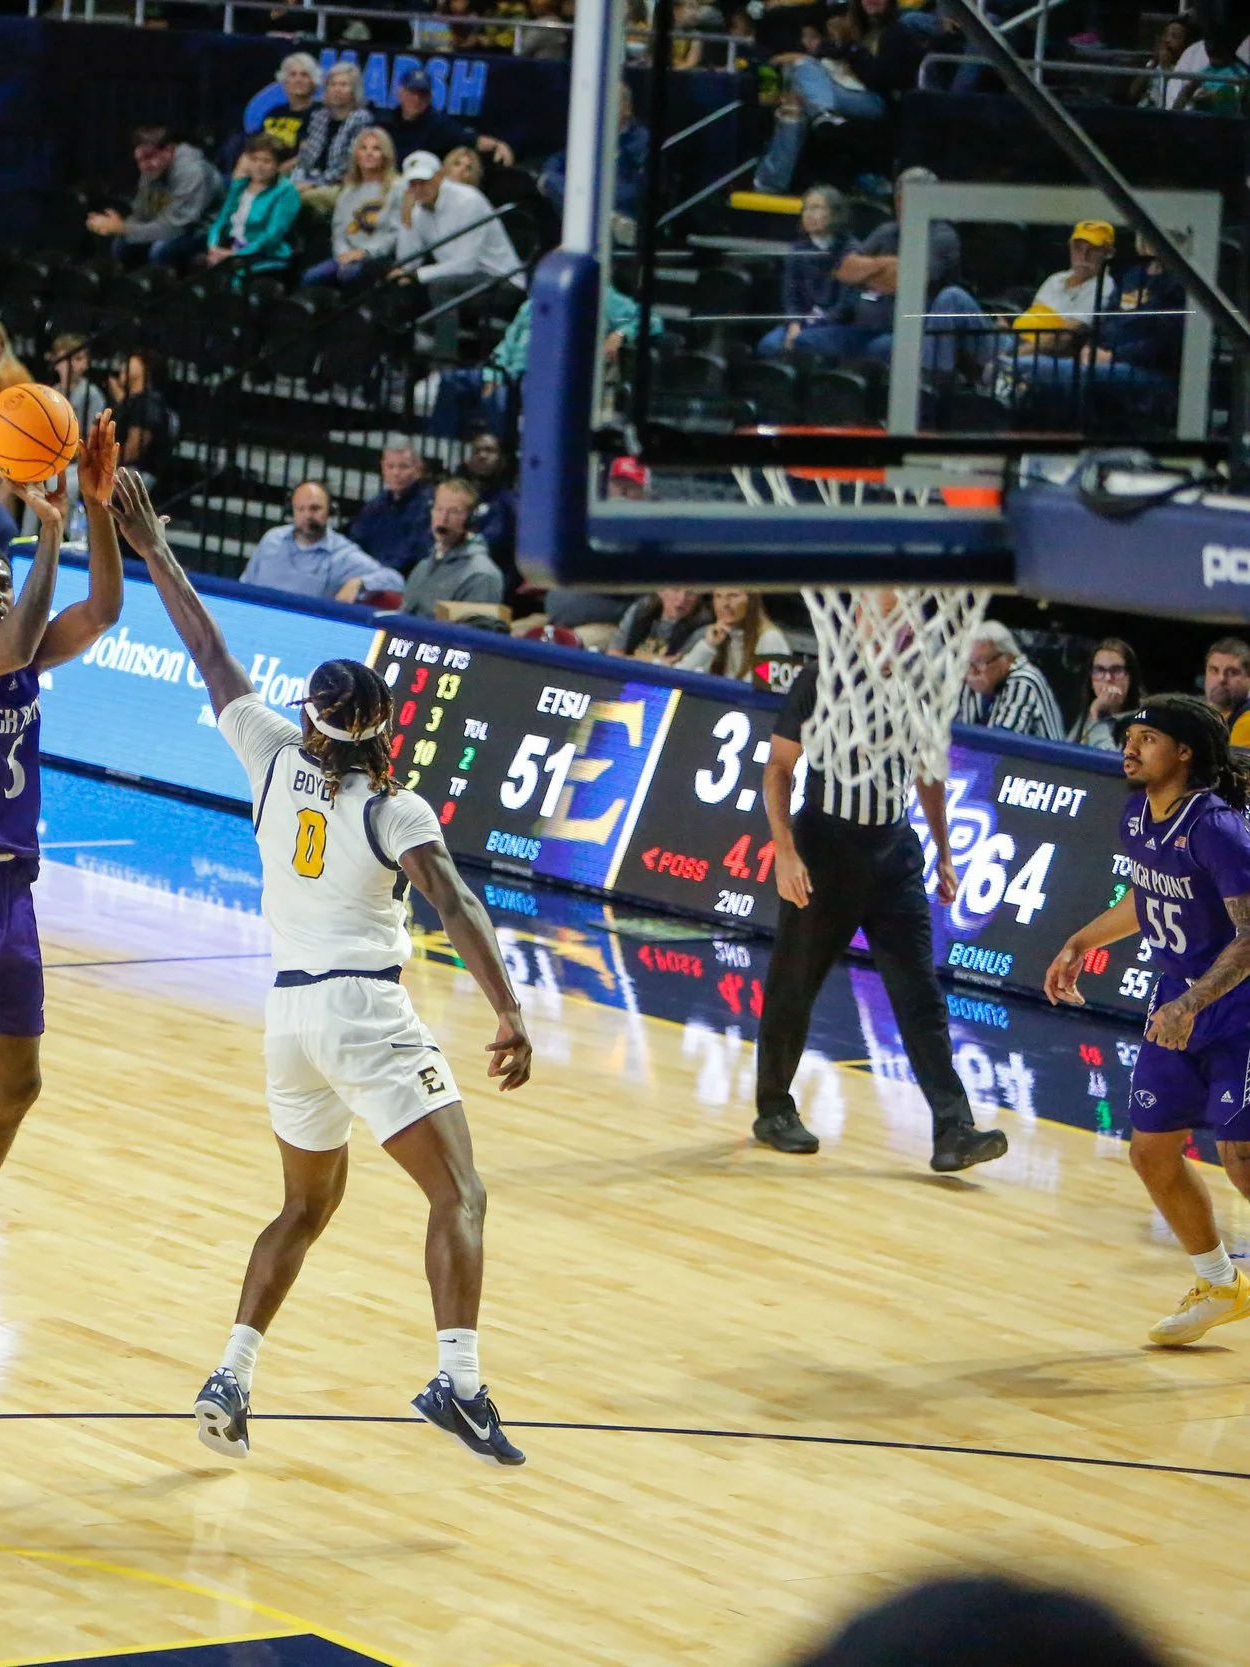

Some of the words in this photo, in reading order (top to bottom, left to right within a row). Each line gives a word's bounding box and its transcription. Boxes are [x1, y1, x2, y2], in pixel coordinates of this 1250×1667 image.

[250, 653, 307, 711] Hon
[410, 667, 429, 694] 3
[435, 673, 462, 700] 13
[398, 700, 417, 726] 0
[425, 706, 444, 732] 3
[536, 685, 592, 720] ETSU
[4, 733, 26, 799] 5
[412, 739, 438, 766] 10
[458, 746, 476, 771] 2
[500, 734, 577, 818] 51
[998, 775, 1055, 812] HIGH
[1051, 785, 1088, 818] PT
[292, 807, 328, 879] 0
[485, 830, 542, 861] BONUS
[965, 832, 1056, 925] 64
[1112, 854, 1132, 877] TO
[1151, 870, 1195, 900] POINT
[714, 889, 756, 917] 2ND
[1146, 897, 1188, 954] 55
[947, 942, 1014, 977] BONUS
[1119, 967, 1153, 999] 55
